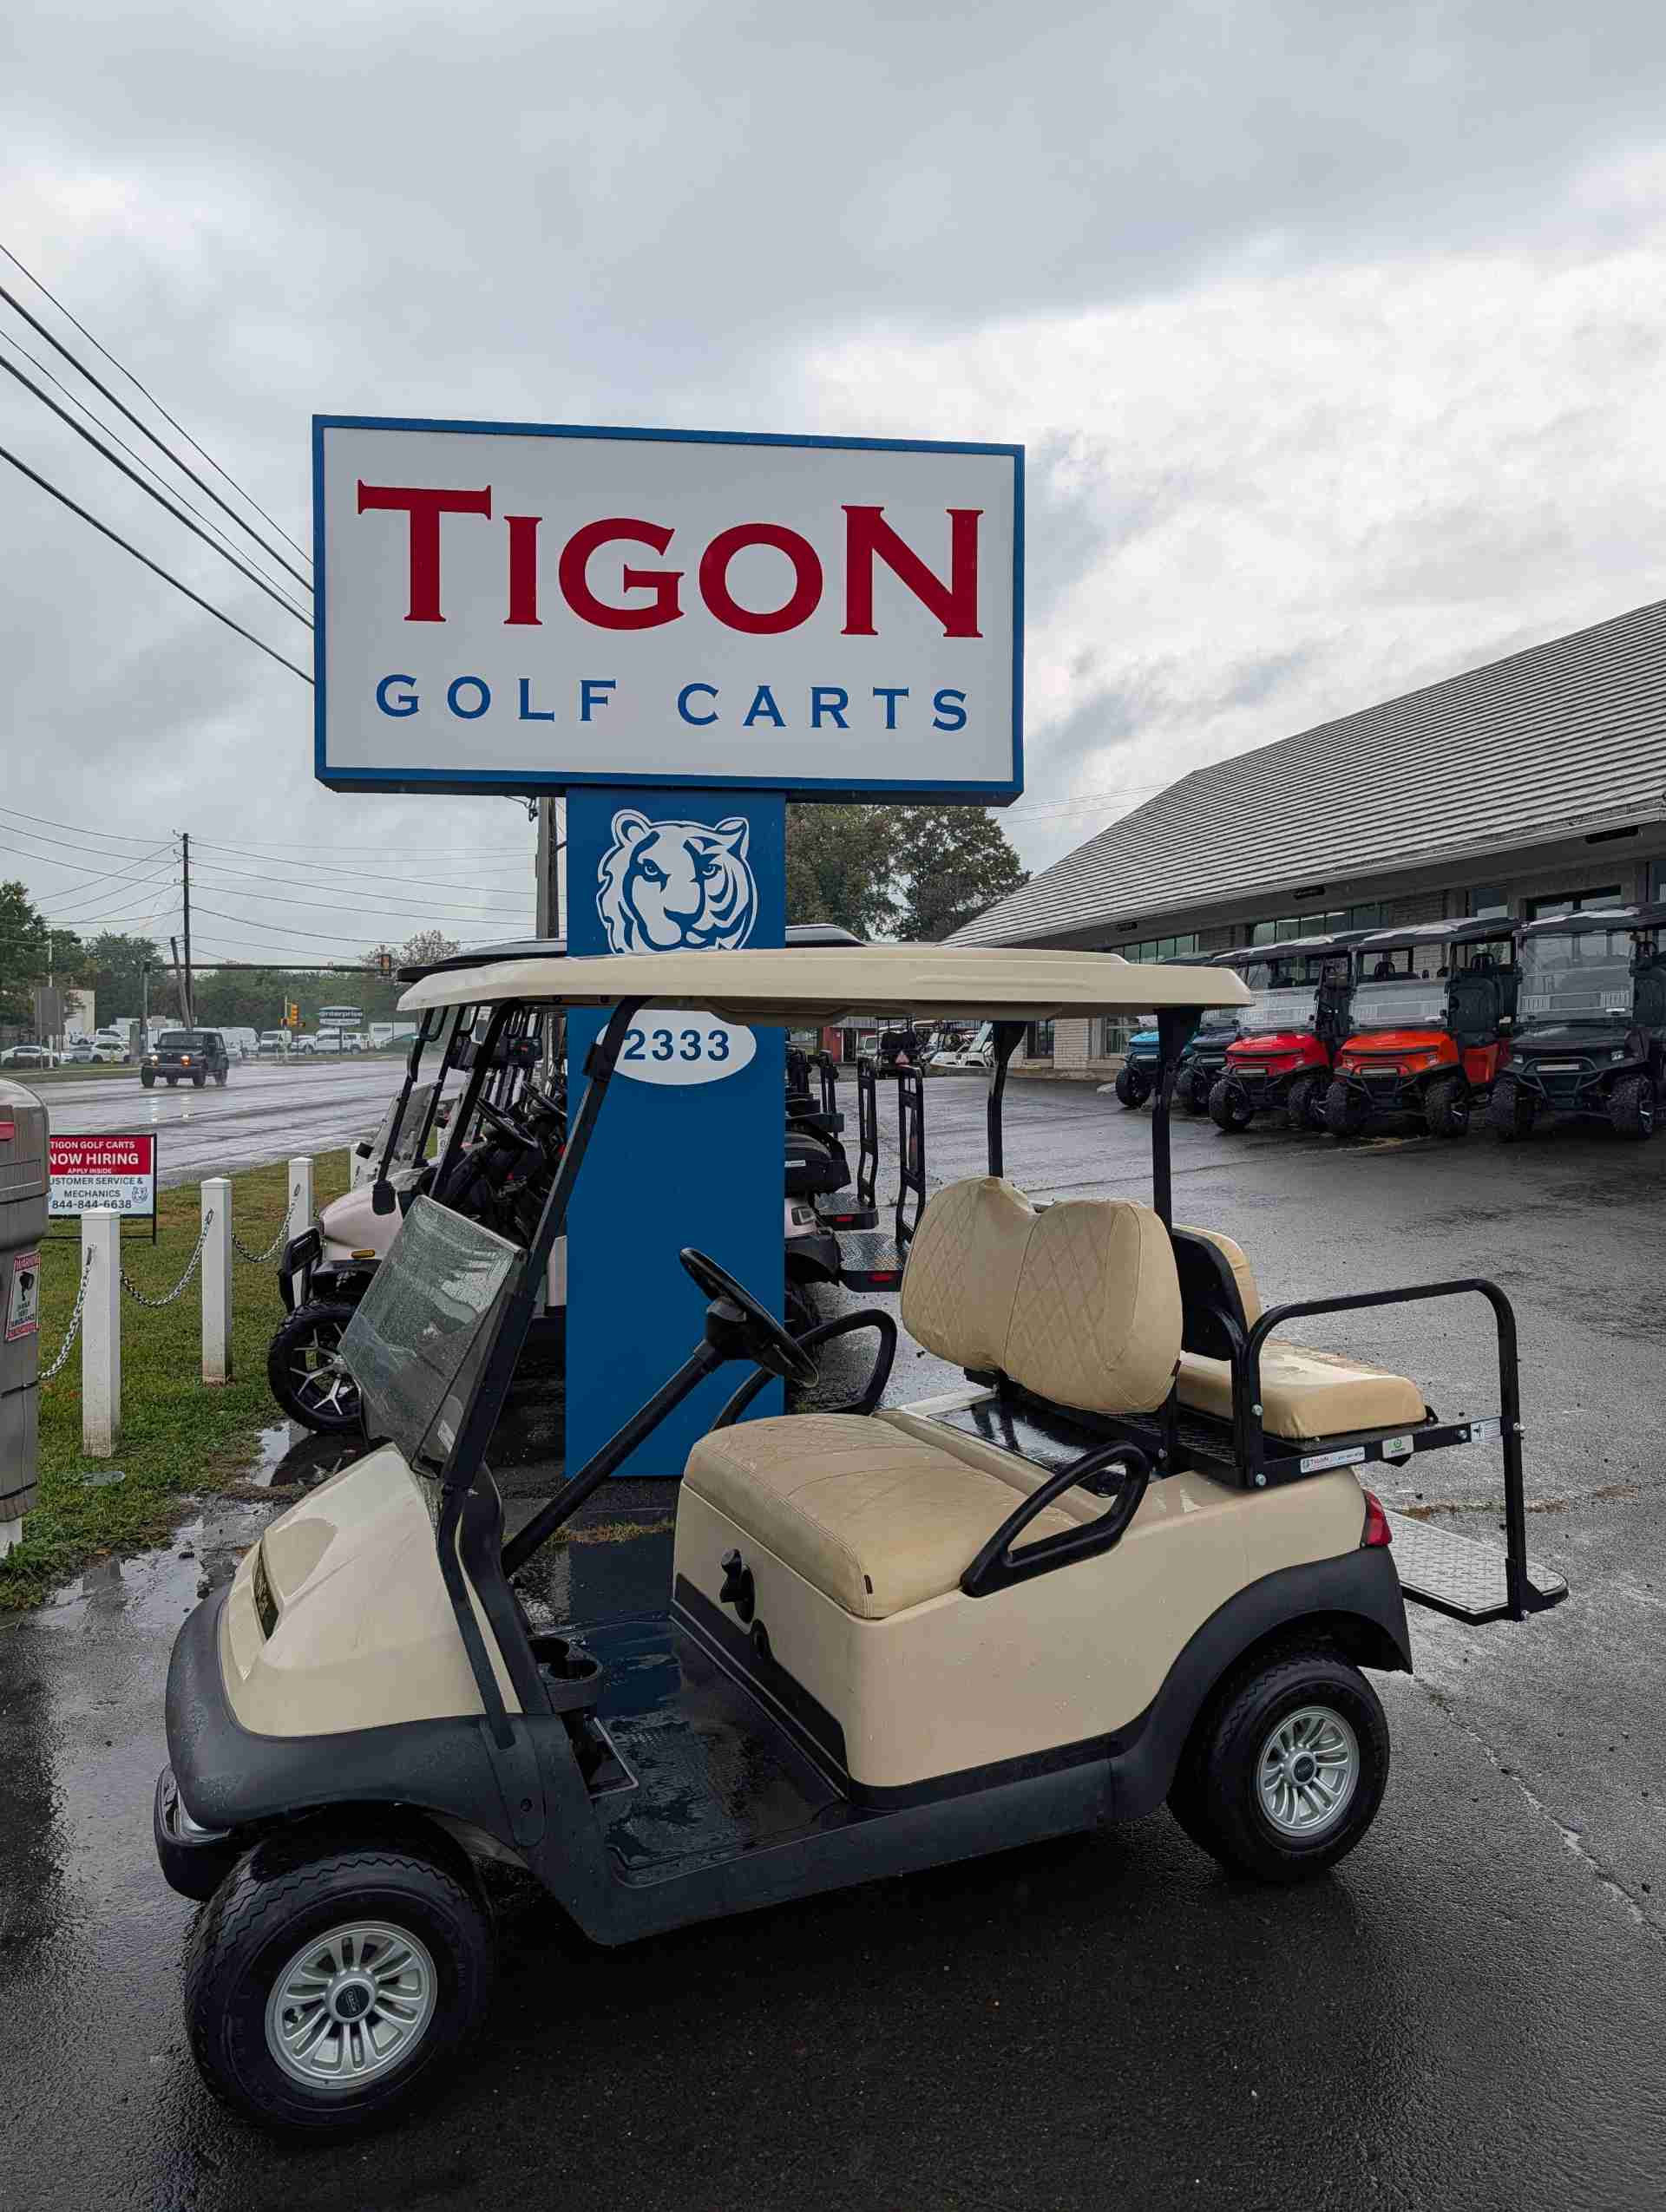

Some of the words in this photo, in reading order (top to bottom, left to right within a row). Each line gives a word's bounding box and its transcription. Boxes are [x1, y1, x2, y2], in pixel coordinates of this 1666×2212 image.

[357, 480, 984, 638] TIGON
[376, 674, 617, 722] GOLF
[677, 683, 967, 731] CARTS
[623, 1029, 730, 1061] 2333
[86, 1153, 139, 1165] HIRING
[52, 1200, 132, 1209] 844-844-6638
[63, 1189, 121, 1198] MECHANICS
